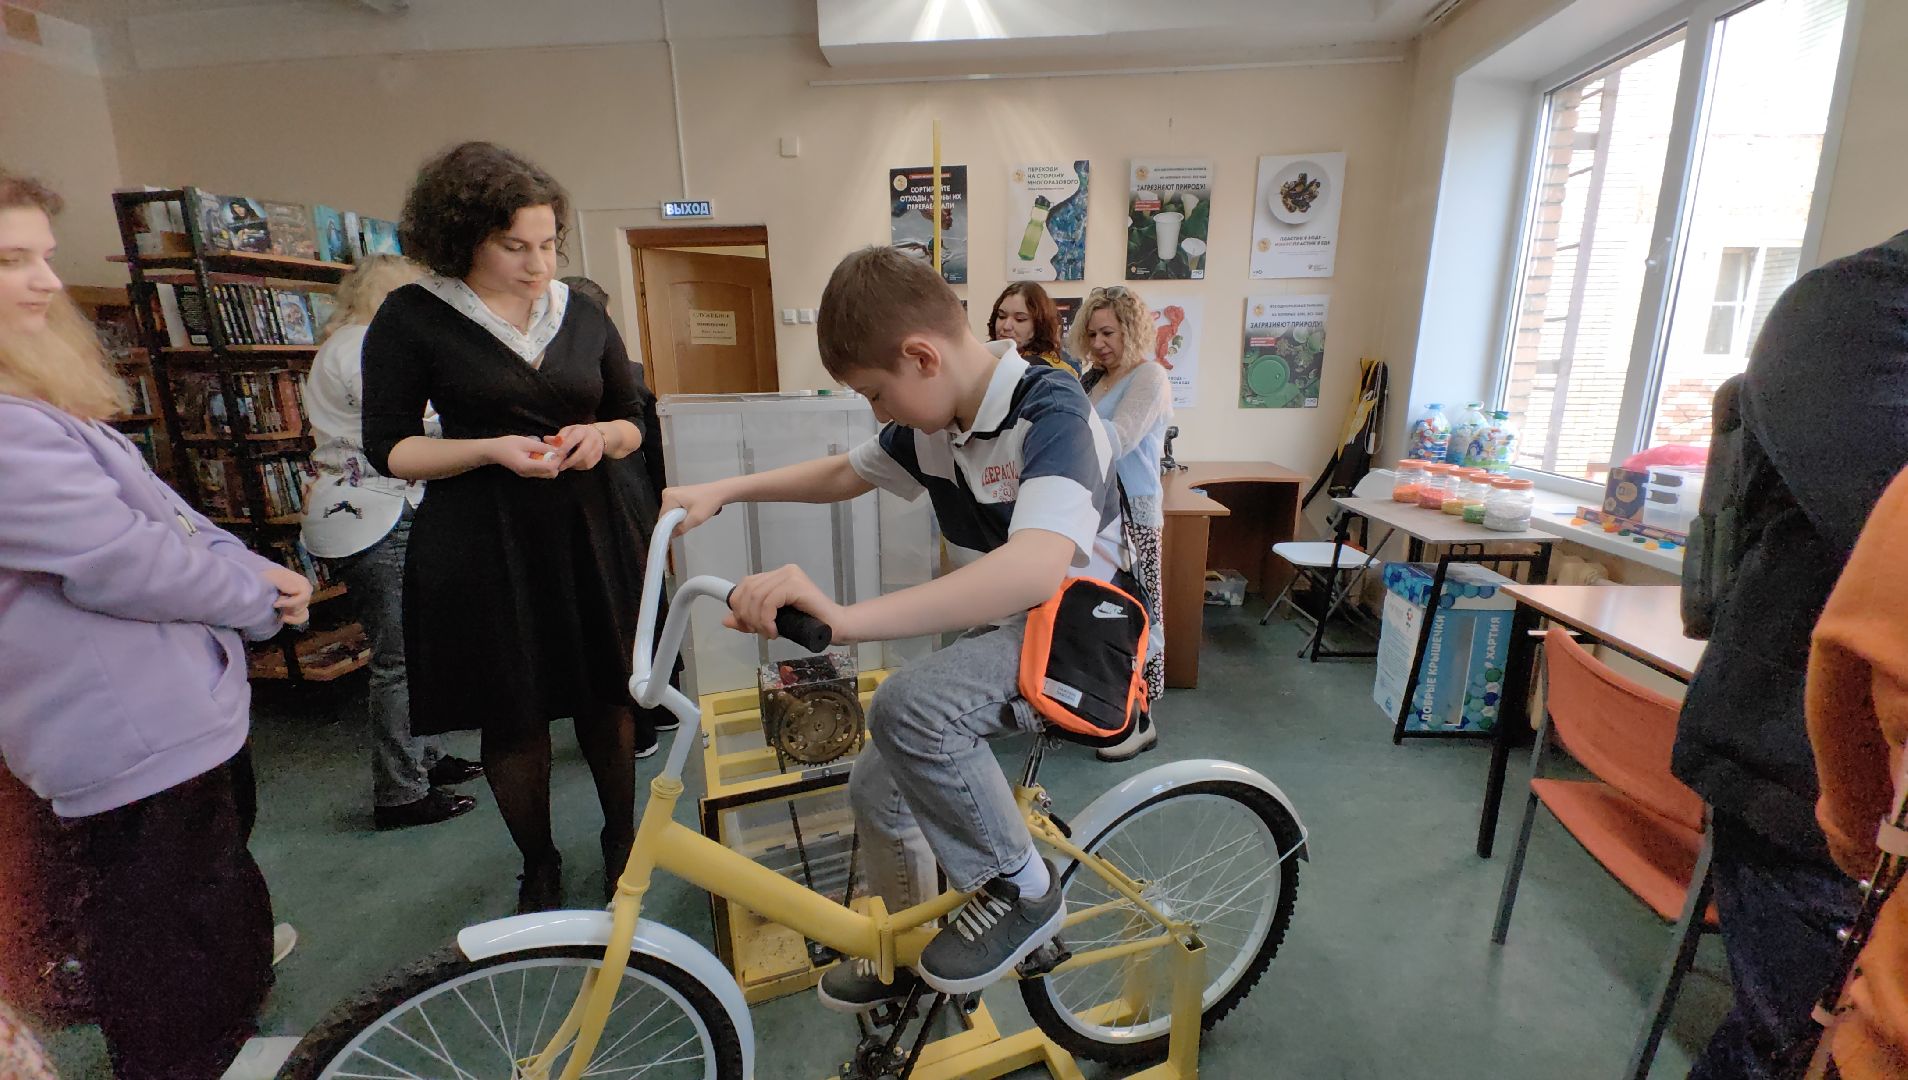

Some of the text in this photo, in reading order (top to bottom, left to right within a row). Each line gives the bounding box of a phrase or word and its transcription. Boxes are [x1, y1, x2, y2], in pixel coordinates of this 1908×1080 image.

[910, 184, 951, 193] СОРТИРЙТЕ
[1136, 183, 1175, 191] ЗАГРЯЗНЯЮТ
[929, 193, 952, 201] ЧБЫ
[666, 203, 709, 215] ВЫХОД
[906, 202, 955, 210] ПЕРЕРАБАЛИ
[1291, 320, 1323, 328] ПРИРОДУ!
[1486, 616, 1501, 659] ХАРТИЯ
[1422, 615, 1446, 721] ДОБРЫЕ КРЫШЕЧКИ
